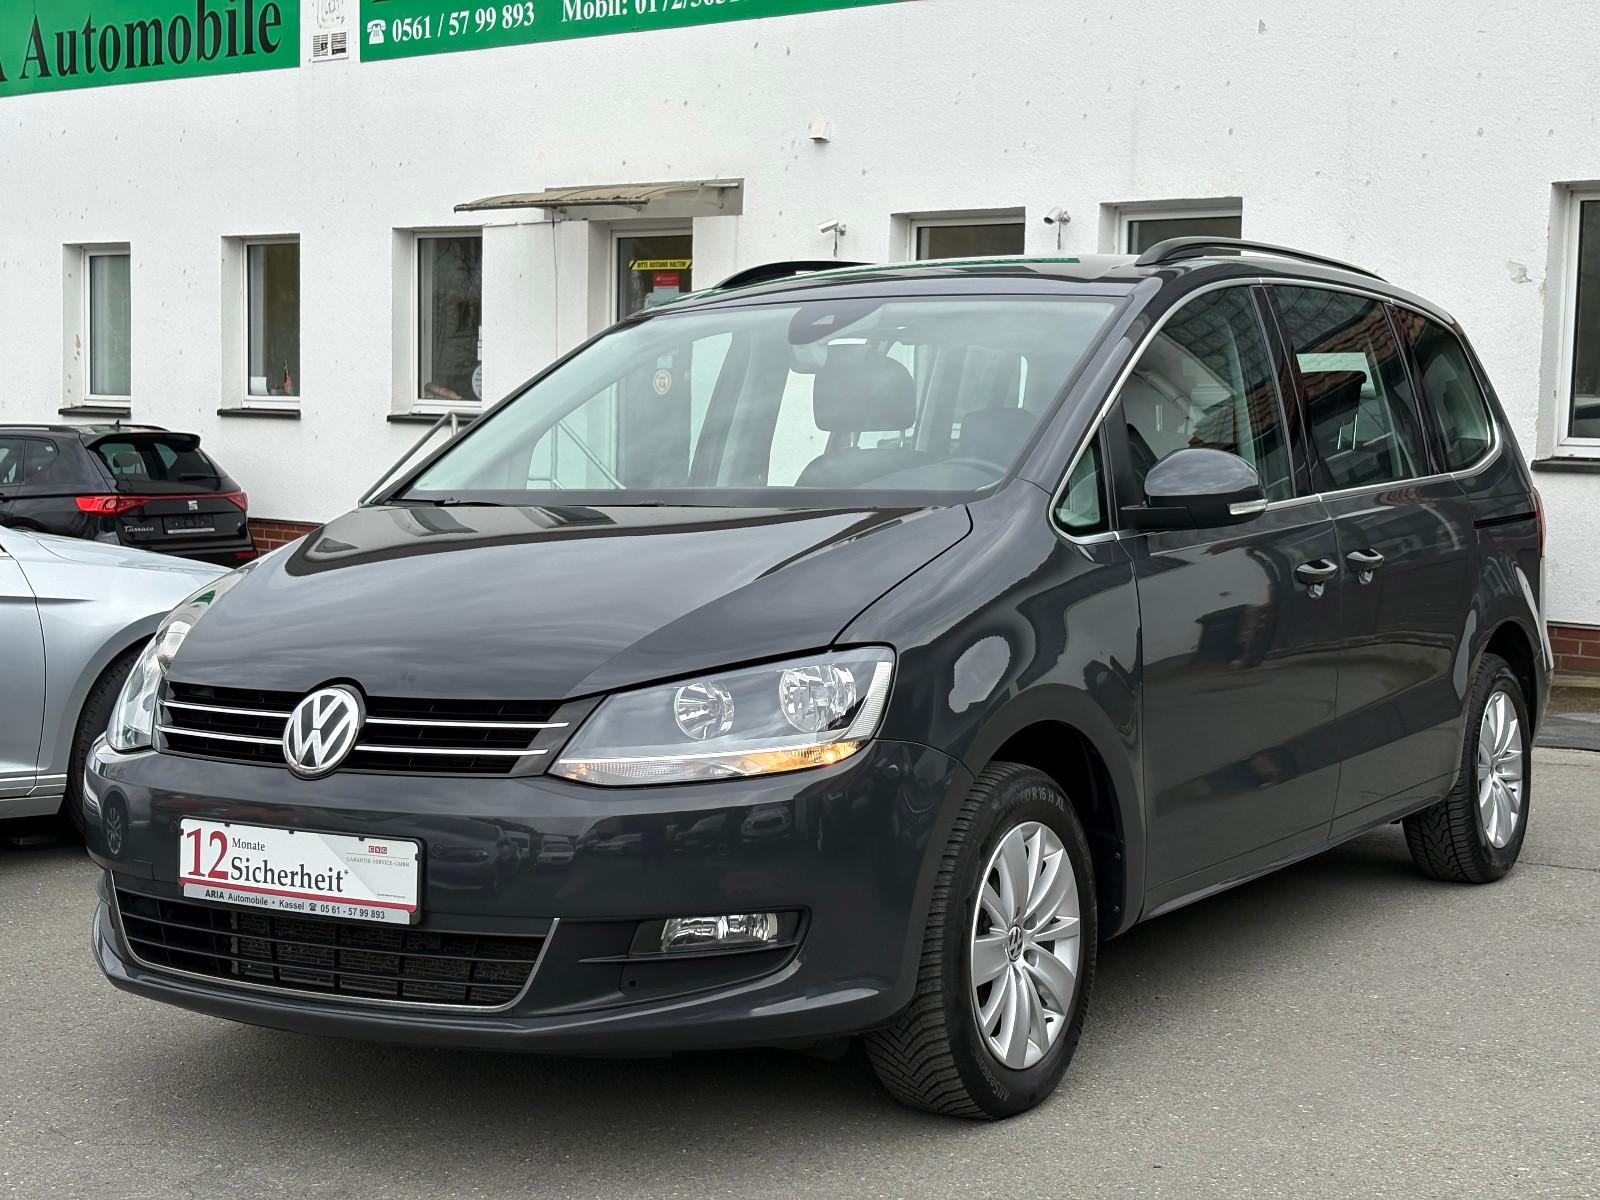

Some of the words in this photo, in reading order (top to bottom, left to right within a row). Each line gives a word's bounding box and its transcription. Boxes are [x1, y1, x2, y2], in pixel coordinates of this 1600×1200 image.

[19, 0, 282, 79] Automobile
[392, 16, 432, 42] 0561
[449, 10, 470, 36] 57
[475, 7, 497, 32] 99
[502, 1, 535, 29] 893
[186, 827, 229, 880] 12
[231, 837, 266, 851] Monate
[204, 889, 225, 900] ARIA
[227, 892, 268, 906] Automobile
[279, 899, 305, 911] Kassel
[348, 907, 358, 917] 57
[359, 908, 369, 918] 99
[370, 909, 385, 920] 893
